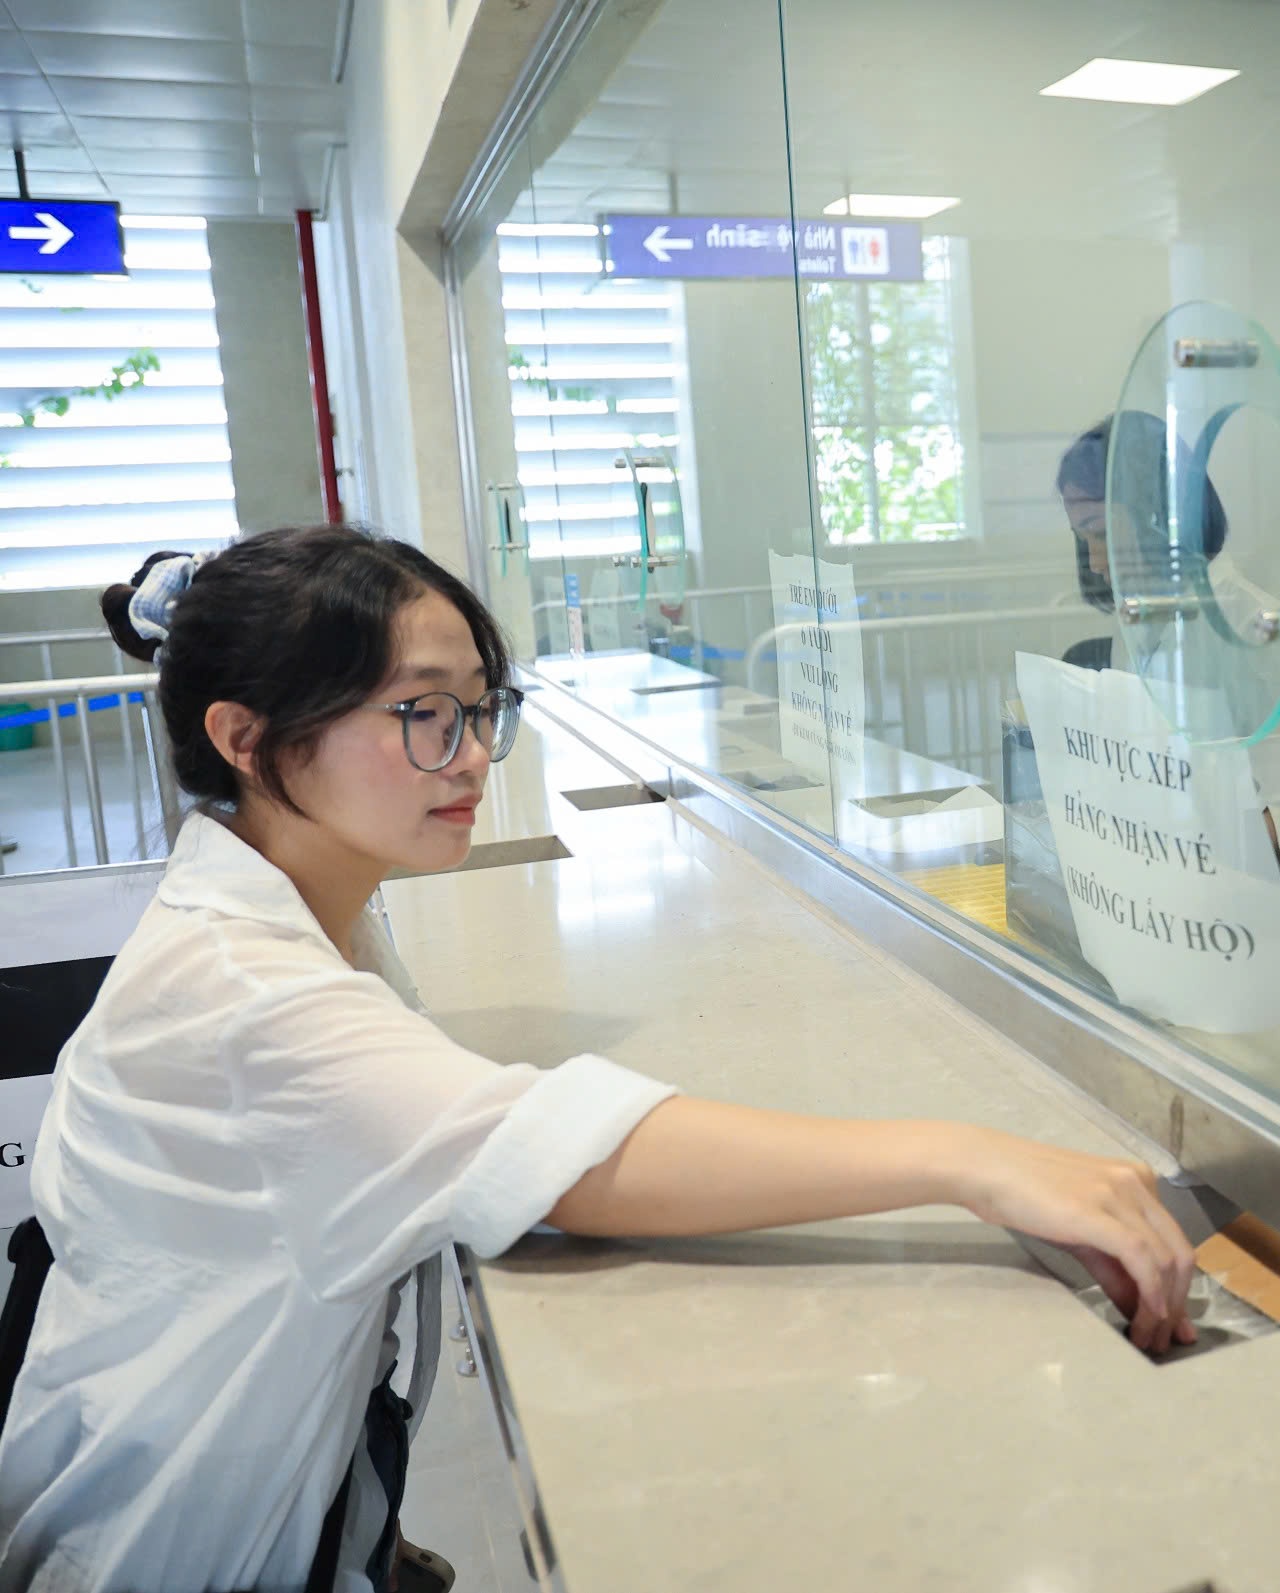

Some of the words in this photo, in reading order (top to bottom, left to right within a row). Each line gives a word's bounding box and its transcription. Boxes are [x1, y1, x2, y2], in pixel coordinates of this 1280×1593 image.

[1063, 726, 1099, 765] KHU
[1103, 738, 1142, 783] VỰC
[1147, 745, 1192, 792] XẾP
[1064, 790, 1107, 841] HÀNG
[1111, 815, 1169, 866] NHẬN
[1174, 833, 1217, 875] VÉ
[1067, 865, 1125, 925] (KHÔNG
[1129, 897, 1174, 944] LẤY
[1183, 917, 1256, 962] HỘ)
